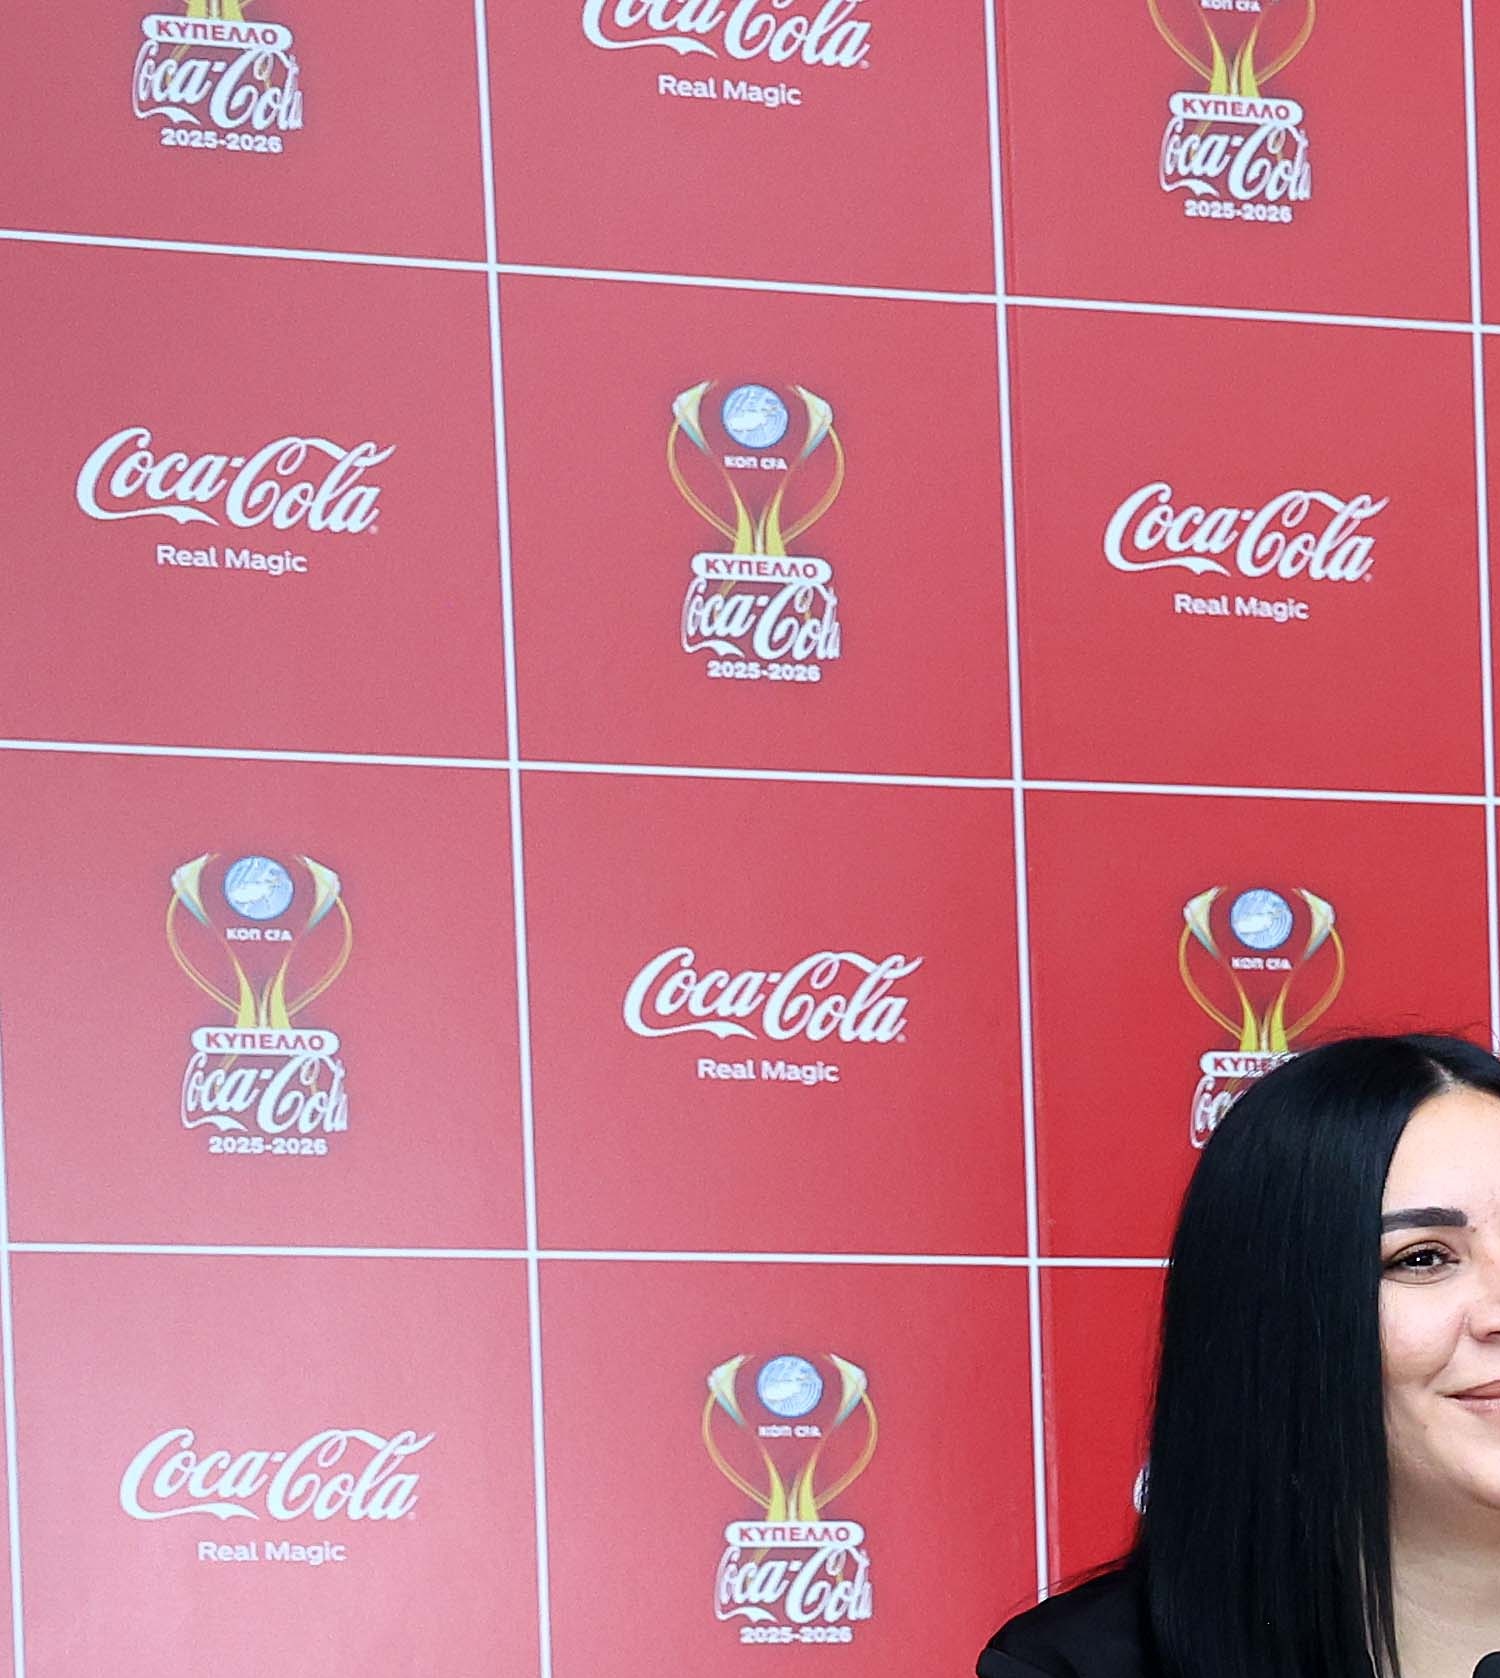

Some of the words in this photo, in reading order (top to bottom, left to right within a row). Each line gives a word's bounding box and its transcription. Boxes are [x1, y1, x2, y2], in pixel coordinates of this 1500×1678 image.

[156, 20, 278, 45] ΚΥΠΕΛΛΟ
[582, 0, 871, 67] CocaCola
[658, 73, 717, 98] Real
[722, 79, 801, 107] Magic
[1182, 98, 1290, 120] ΚΥΠΕΛΛΟ
[160, 127, 282, 153] 2025-2026
[1184, 199, 1292, 222] 2025-2026
[76, 426, 396, 533] Coca-Cola
[1104, 482, 1389, 581] Coca-Cola
[156, 544, 218, 567] Real
[224, 548, 307, 575] Magic
[704, 558, 818, 578] ΚΥΠΕΛΛΟ
[1174, 593, 1229, 615] Real
[1234, 596, 1308, 622] Magic
[707, 660, 820, 682] 2025-2026
[623, 946, 922, 1042] Coca-Cola
[205, 1032, 324, 1051] ΚΥΠΕΛΛΟ
[697, 1058, 755, 1079] Real
[761, 1060, 838, 1085] Magic
[208, 1135, 327, 1155] 2025-2026
[119, 1427, 435, 1520] Coca-Cola
[738, 1525, 850, 1542] ΚΥΠΕΛΛΟ
[197, 1540, 258, 1561] Real
[264, 1540, 346, 1565] Magic
[740, 1626, 852, 1643] 2025-2026
